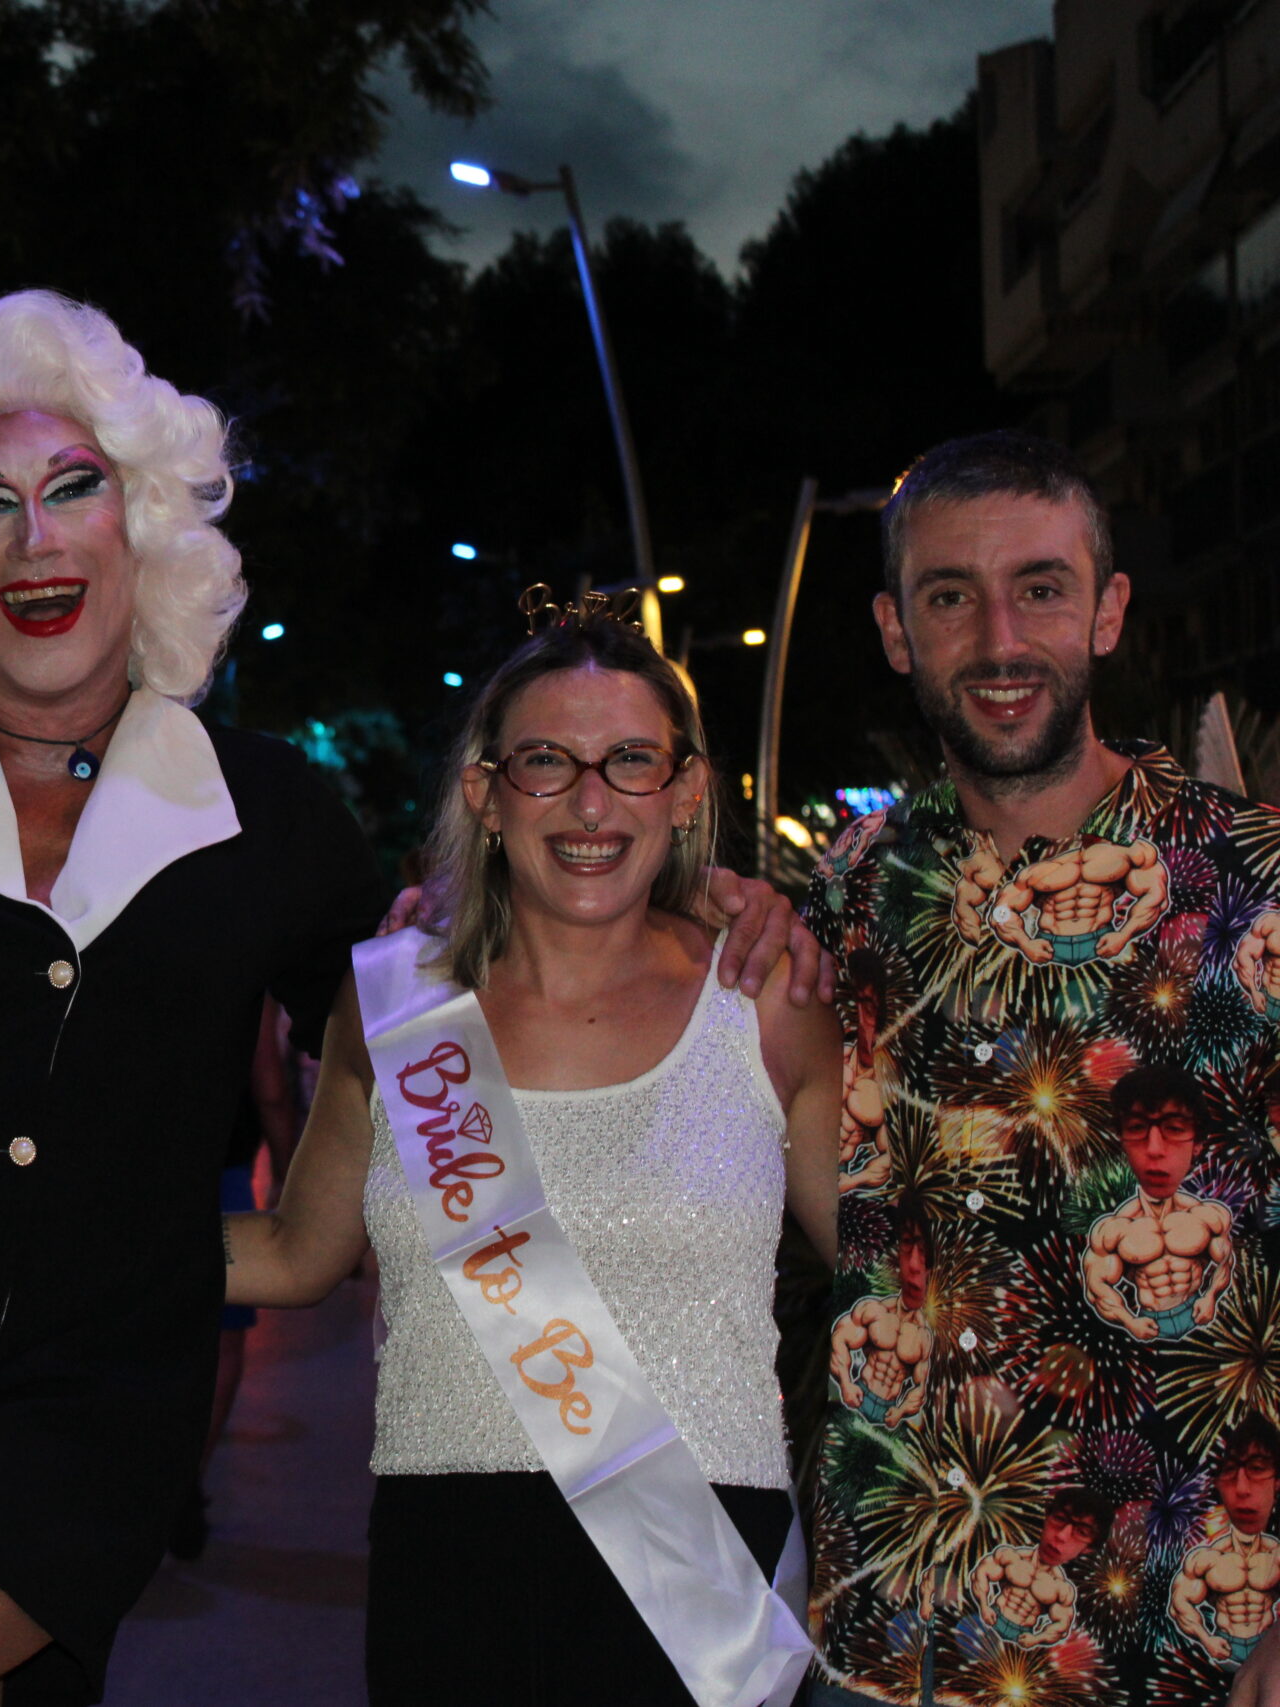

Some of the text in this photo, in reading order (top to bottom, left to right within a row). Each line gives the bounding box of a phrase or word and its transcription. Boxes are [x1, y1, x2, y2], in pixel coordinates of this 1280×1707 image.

[396, 1041, 595, 1436] Bride to Be
